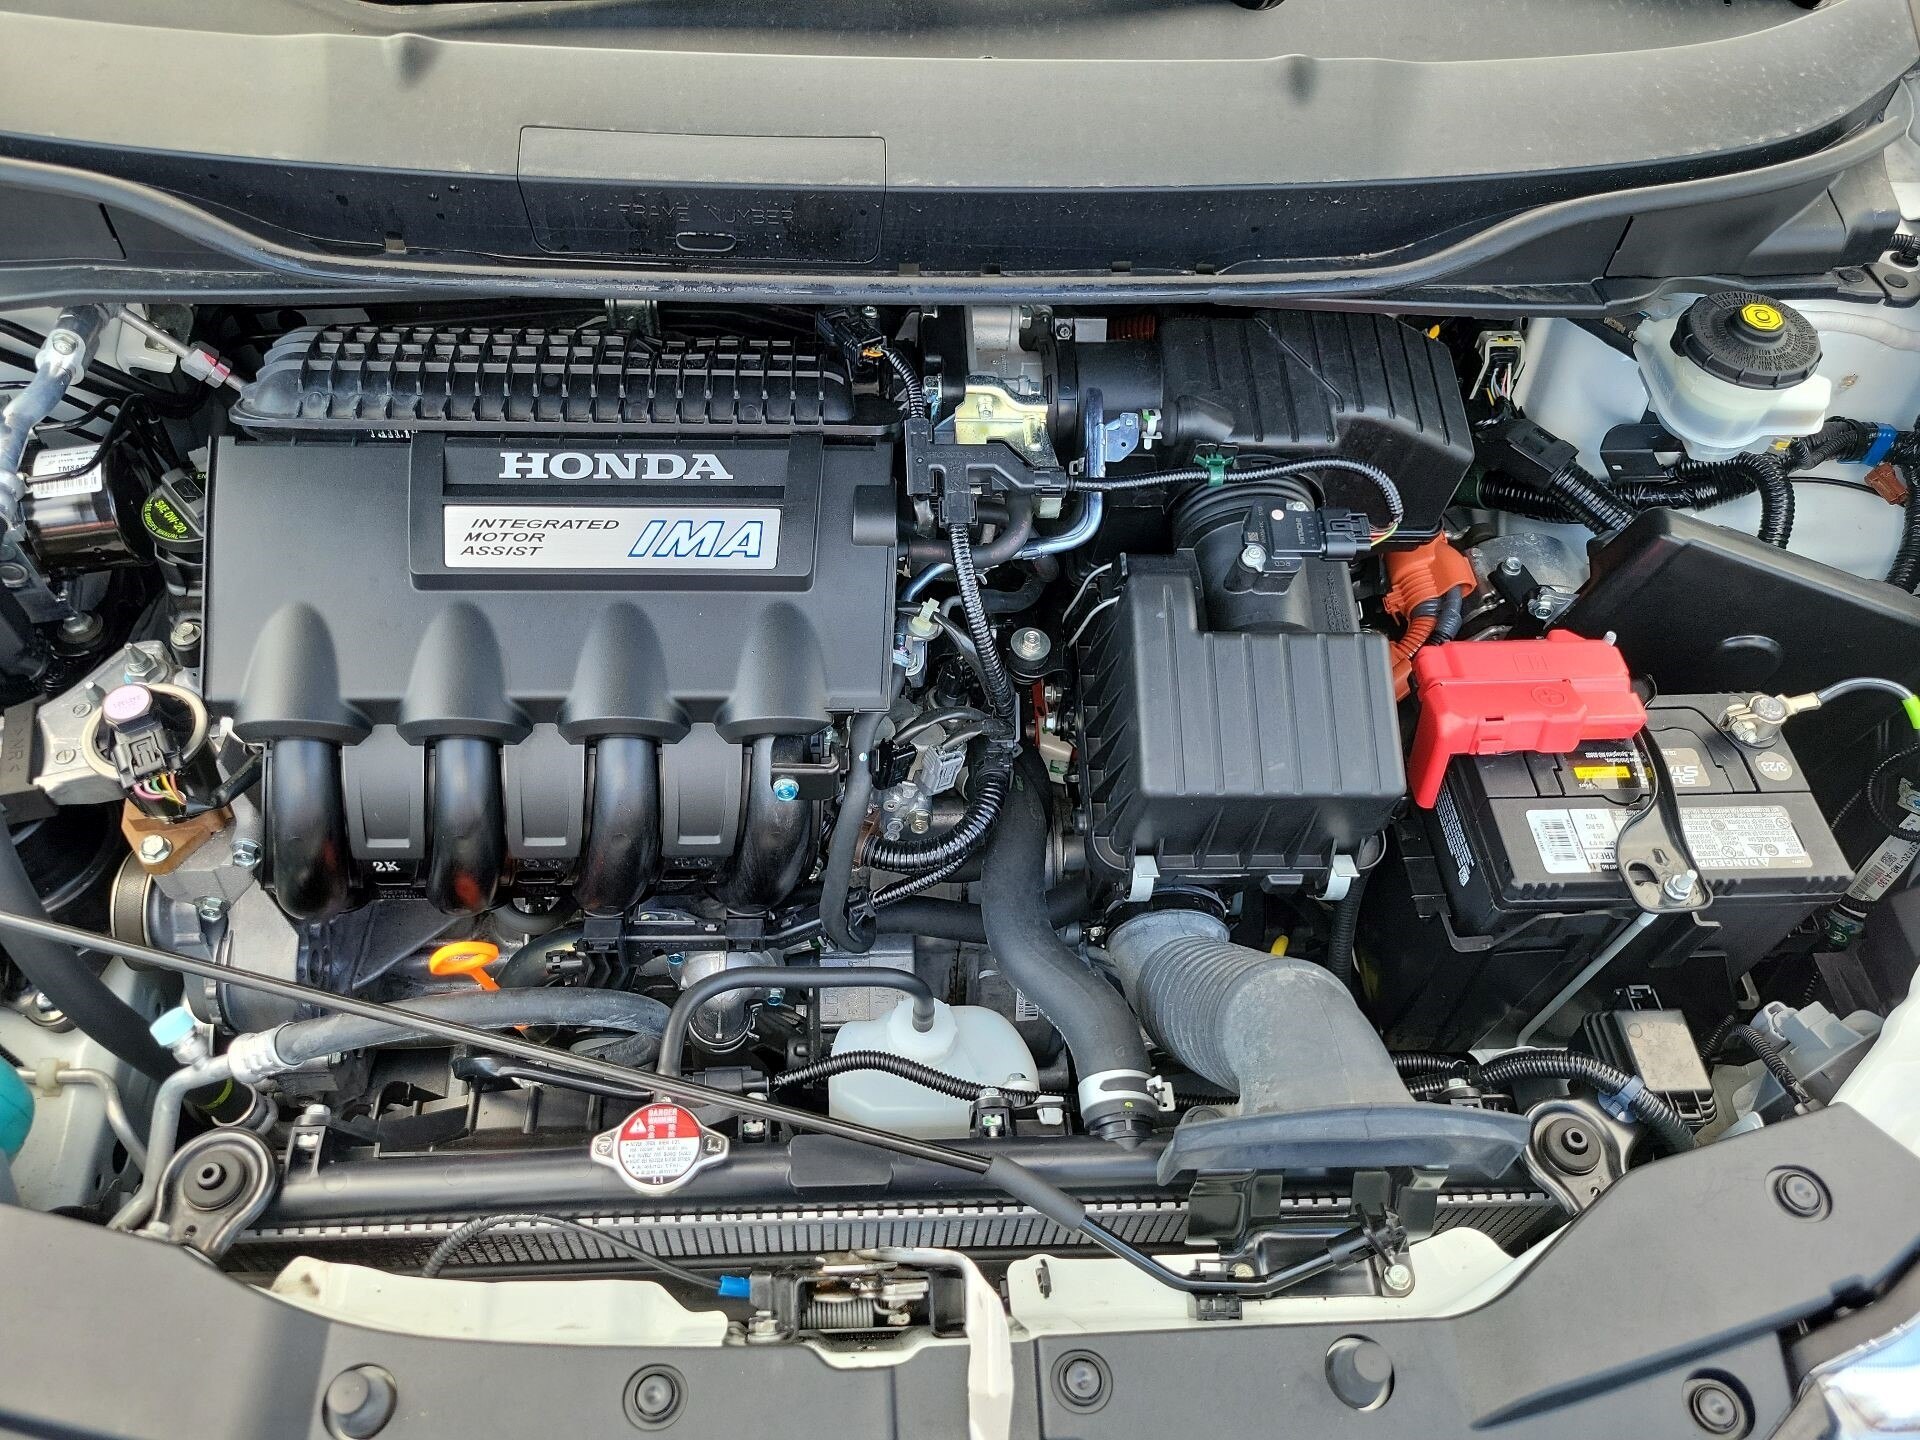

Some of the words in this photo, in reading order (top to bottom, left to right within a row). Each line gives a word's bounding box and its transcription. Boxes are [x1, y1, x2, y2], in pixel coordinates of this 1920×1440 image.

[499, 452, 734, 480] HONDA
[154, 499, 170, 514] SAE
[470, 518, 620, 530] INTEGRATED
[464, 532, 546, 543] MOTOR
[627, 520, 763, 558] IMA
[460, 546, 544, 557] ASSIST
[1761, 762, 1787, 772] 3/23
[372, 861, 400, 872] 2K
[648, 1108, 677, 1117] DANGER
